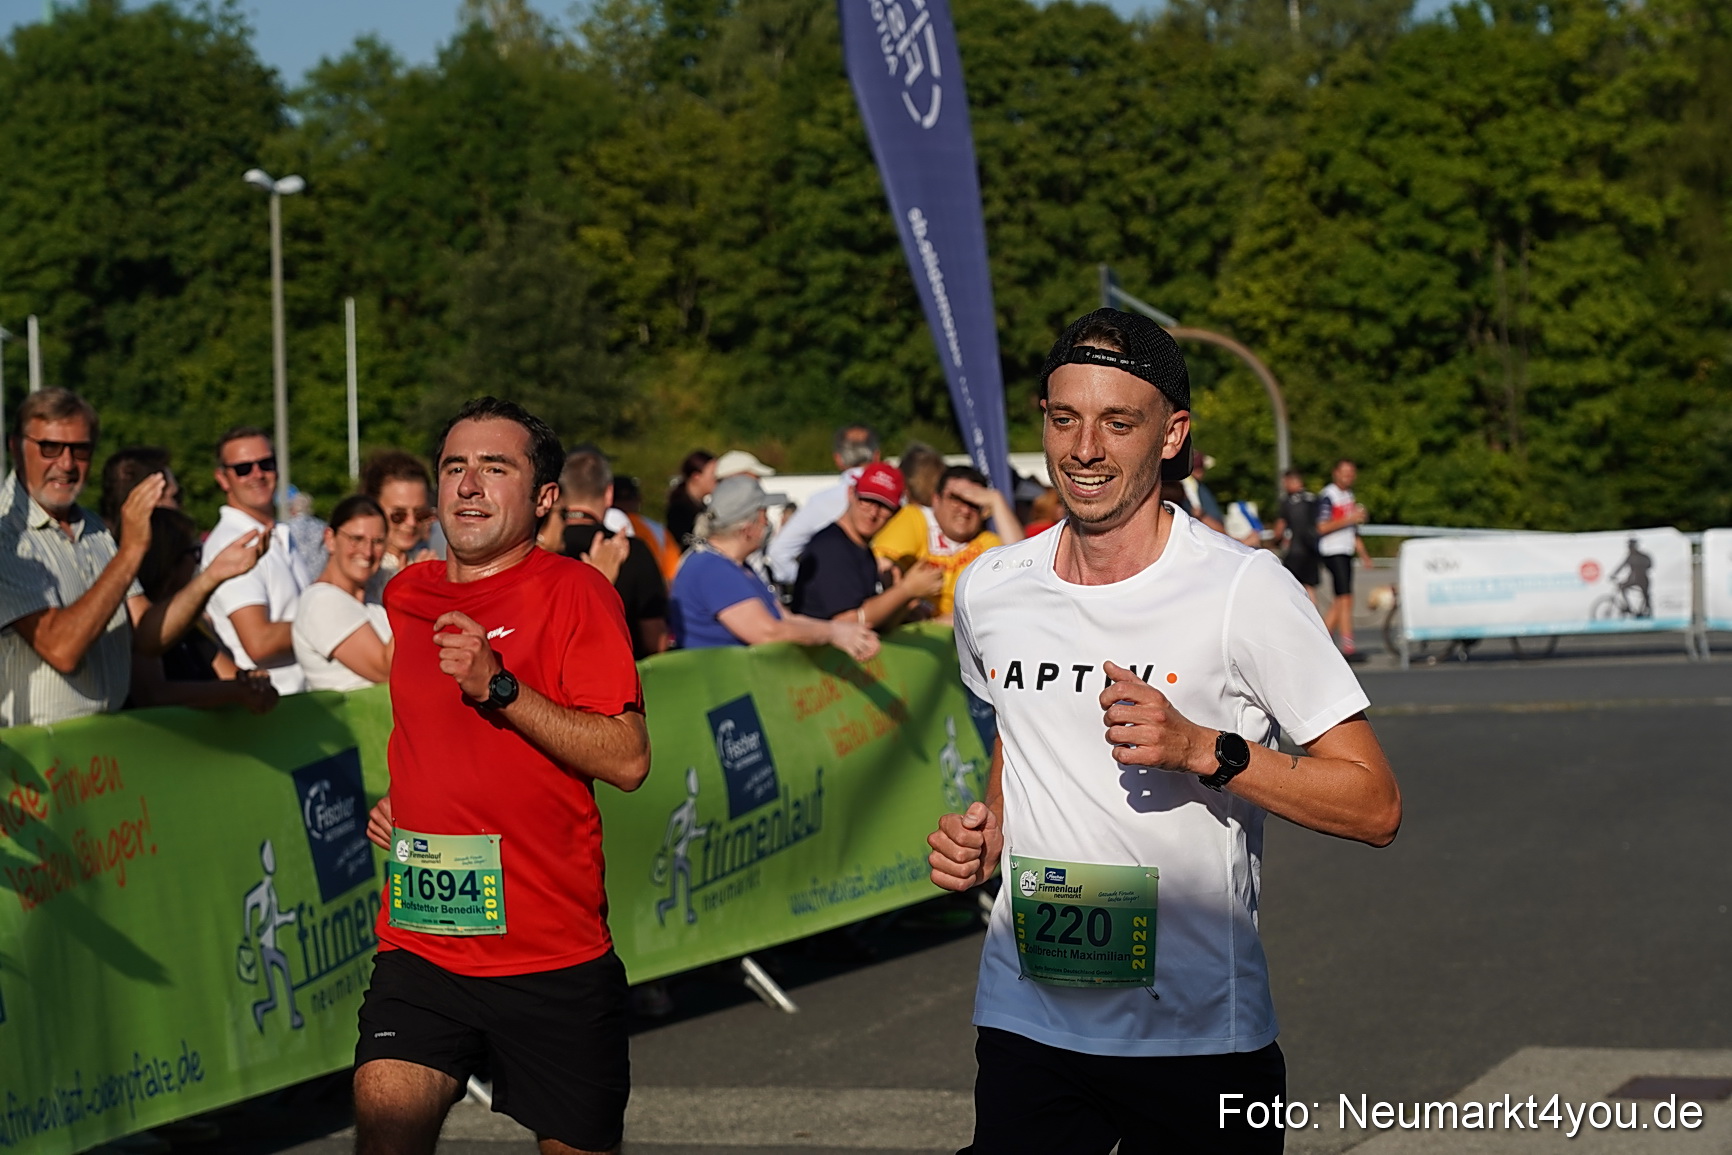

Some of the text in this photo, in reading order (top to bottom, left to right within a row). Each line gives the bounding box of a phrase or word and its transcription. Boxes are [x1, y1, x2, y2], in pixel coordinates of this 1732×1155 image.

[393, 873, 403, 910] RUN
[403, 865, 481, 902] 1694
[483, 874, 498, 921] 2022
[1038, 883, 1083, 894] Firmenlauf
[401, 899, 486, 915] Hofstetter Benedikt
[1035, 902, 1113, 948] 220
[297, 886, 382, 979] firmen
[1131, 916, 1148, 970] 2022
[1069, 948, 1132, 962] Maximilian
